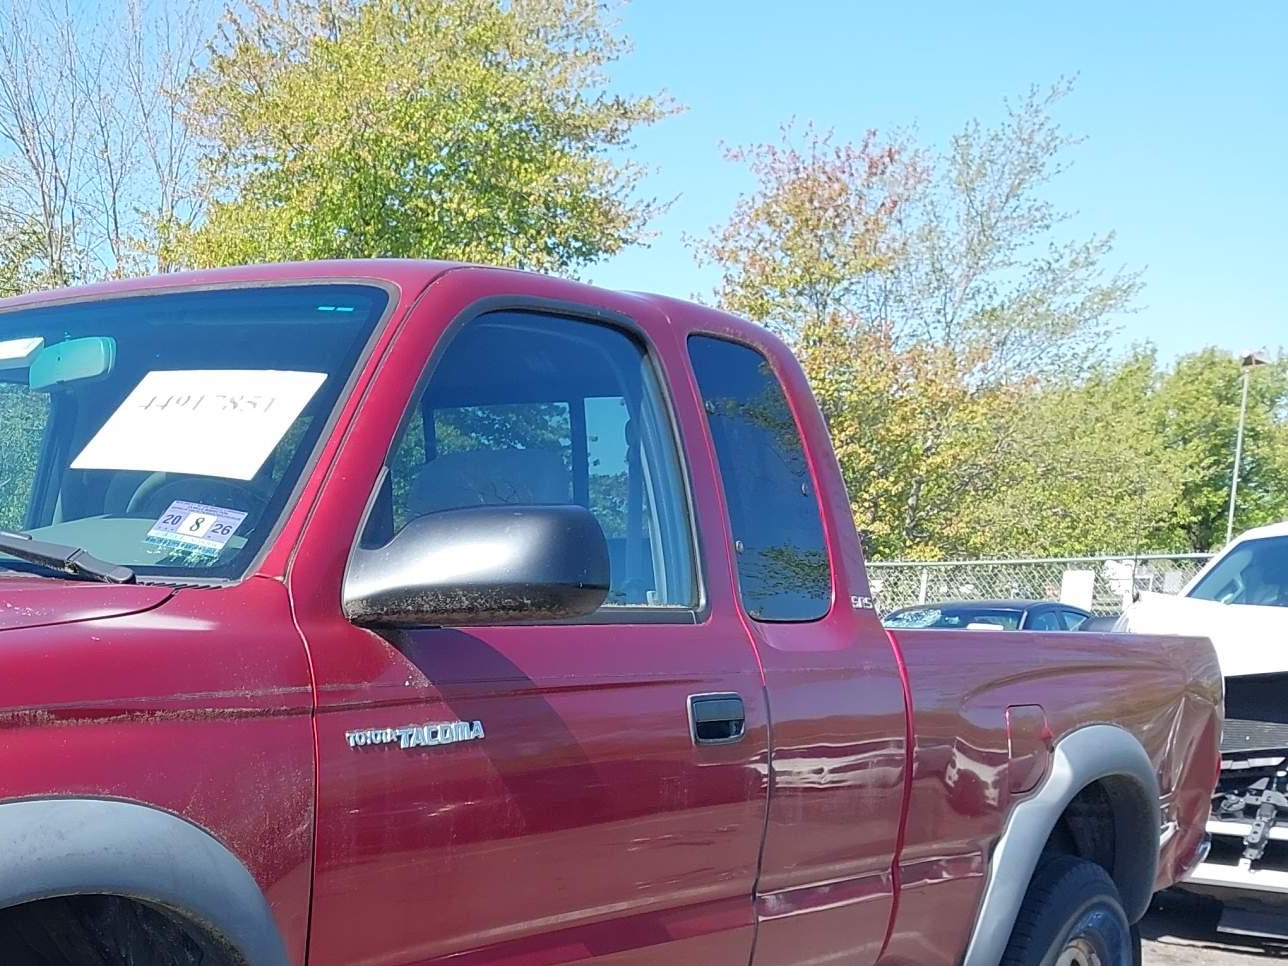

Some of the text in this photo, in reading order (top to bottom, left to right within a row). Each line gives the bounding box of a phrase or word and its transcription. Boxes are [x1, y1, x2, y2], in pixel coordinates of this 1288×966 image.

[163, 514, 233, 535] 20 8 26
[345, 720, 485, 749] TOYOTA TACOMA
